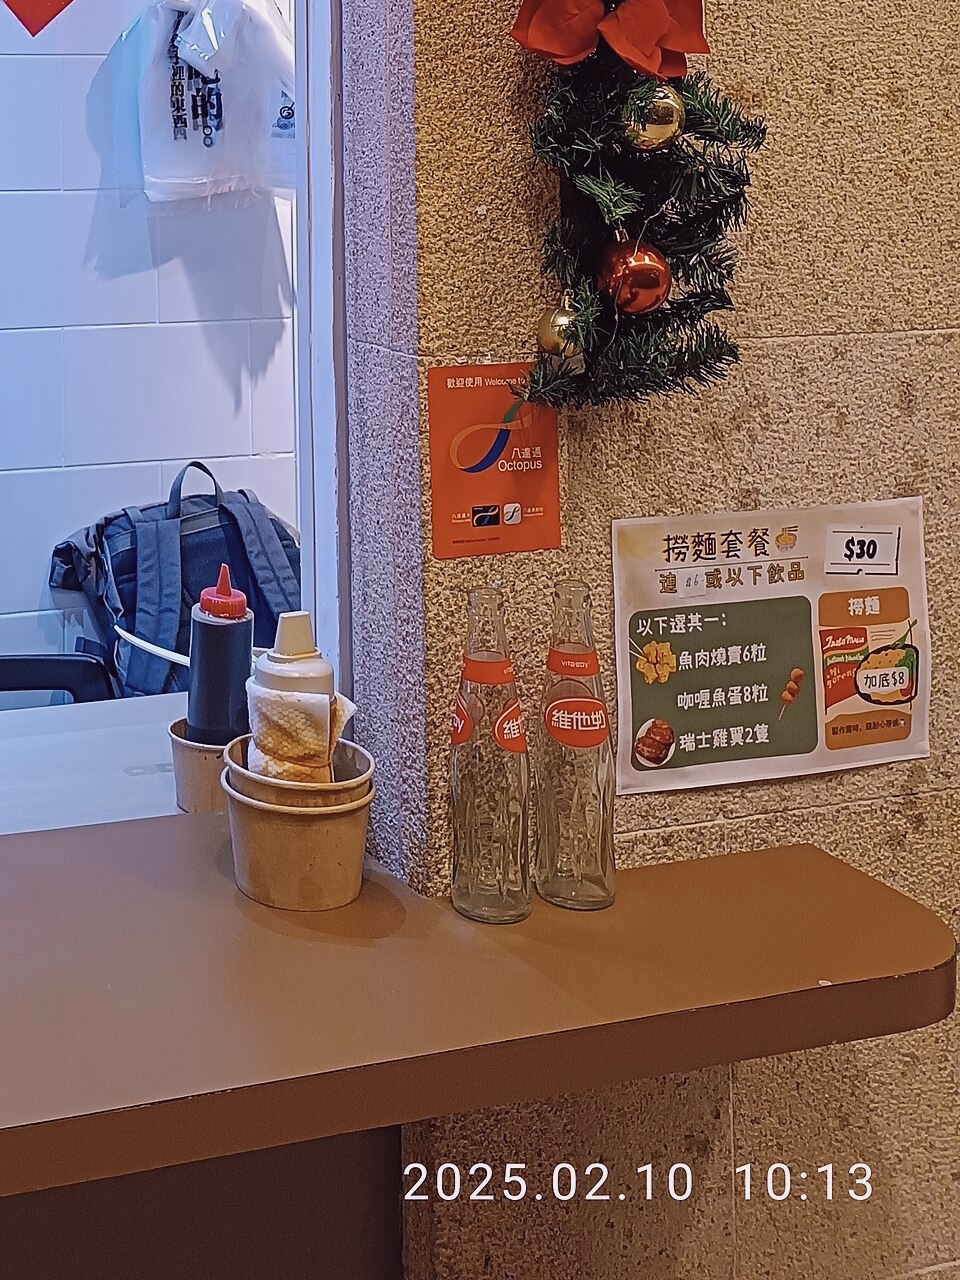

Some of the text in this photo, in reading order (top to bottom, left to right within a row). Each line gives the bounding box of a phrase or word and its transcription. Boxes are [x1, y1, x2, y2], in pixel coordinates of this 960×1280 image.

[511, 446, 541, 459] 八達通
[498, 460, 542, 472] Octopus
[662, 528, 770, 563] 撈麵套餐
[844, 536, 877, 562] $30
[659, 572, 678, 594] 連
[705, 562, 805, 589] 或以下飲品
[848, 596, 880, 616] 撈麵
[636, 612, 726, 636] 以下選其一:
[561, 660, 589, 669] vitasoy
[679, 643, 767, 671] 魚肉燒賣6粒
[864, 671, 905, 689] 加底$8
[677, 683, 769, 710] 咖喱魚蛋8粒
[679, 723, 770, 752] 瑞士雞翼2隻
